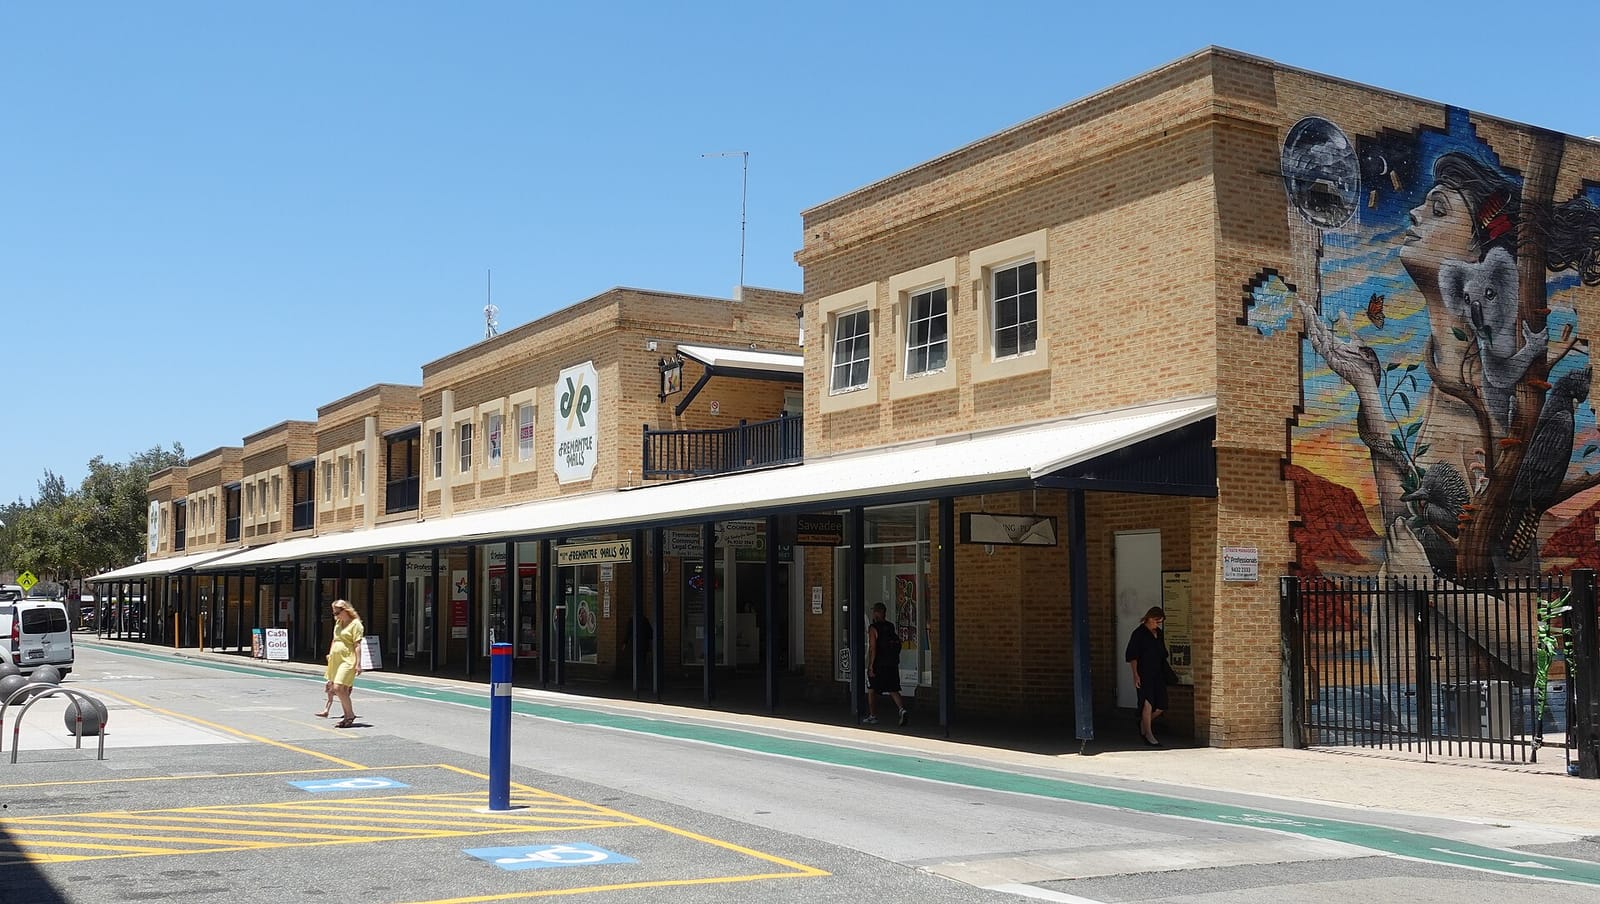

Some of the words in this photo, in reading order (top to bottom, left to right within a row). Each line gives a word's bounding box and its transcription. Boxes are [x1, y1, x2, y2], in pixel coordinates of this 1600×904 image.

[558, 436, 592, 457] FREMANTLE
[566, 451, 585, 468] MALLS
[797, 518, 842, 531] Sawadee
[568, 548, 598, 561] FREMANTLE
[600, 546, 617, 559] MALLS
[268, 640, 287, 648] Gold
